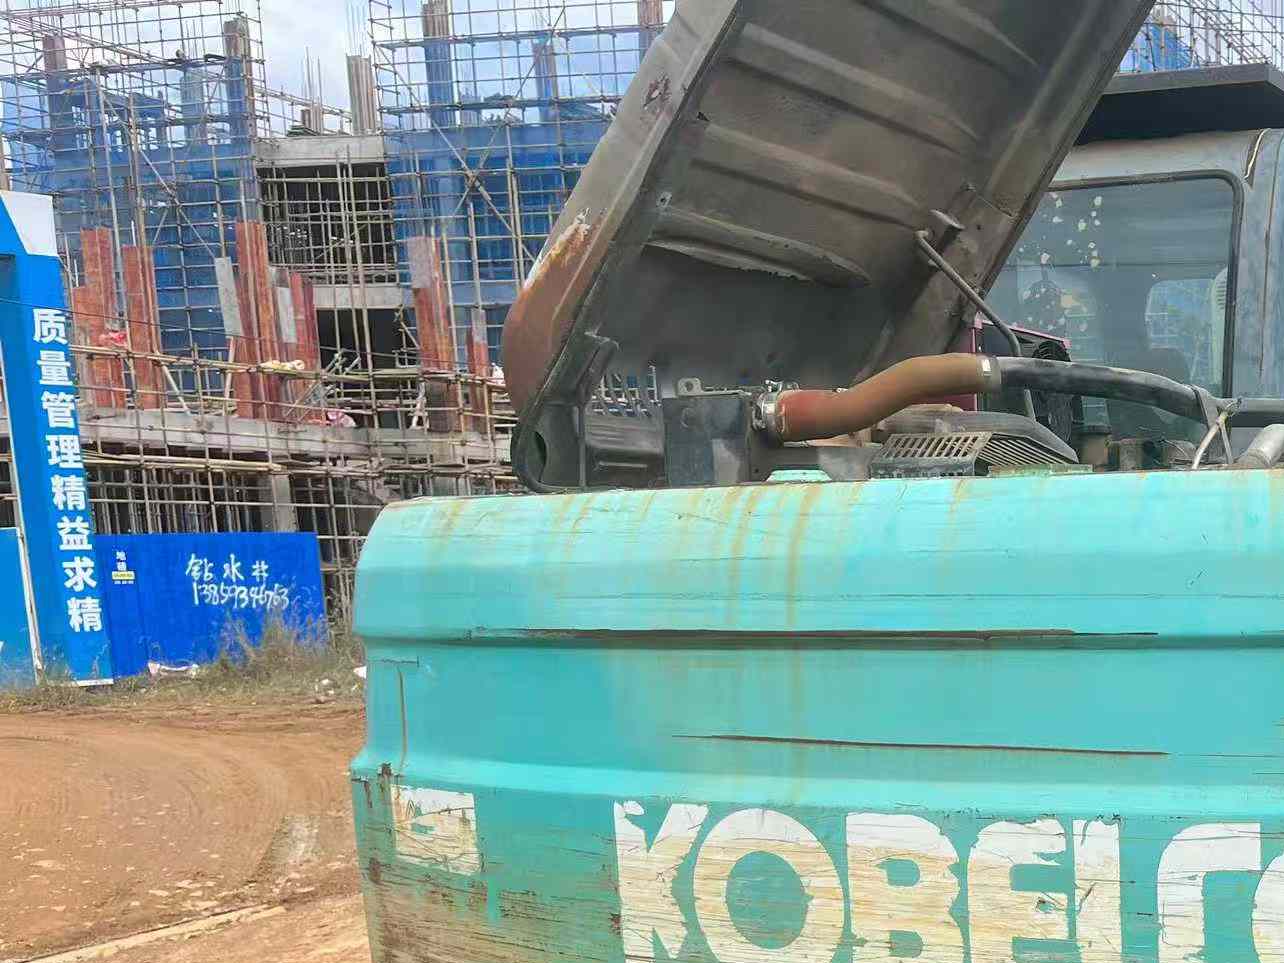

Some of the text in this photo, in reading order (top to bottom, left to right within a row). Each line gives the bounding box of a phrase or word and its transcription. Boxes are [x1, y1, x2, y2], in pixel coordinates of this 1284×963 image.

[32, 308, 102, 632] 质量管理精益求精
